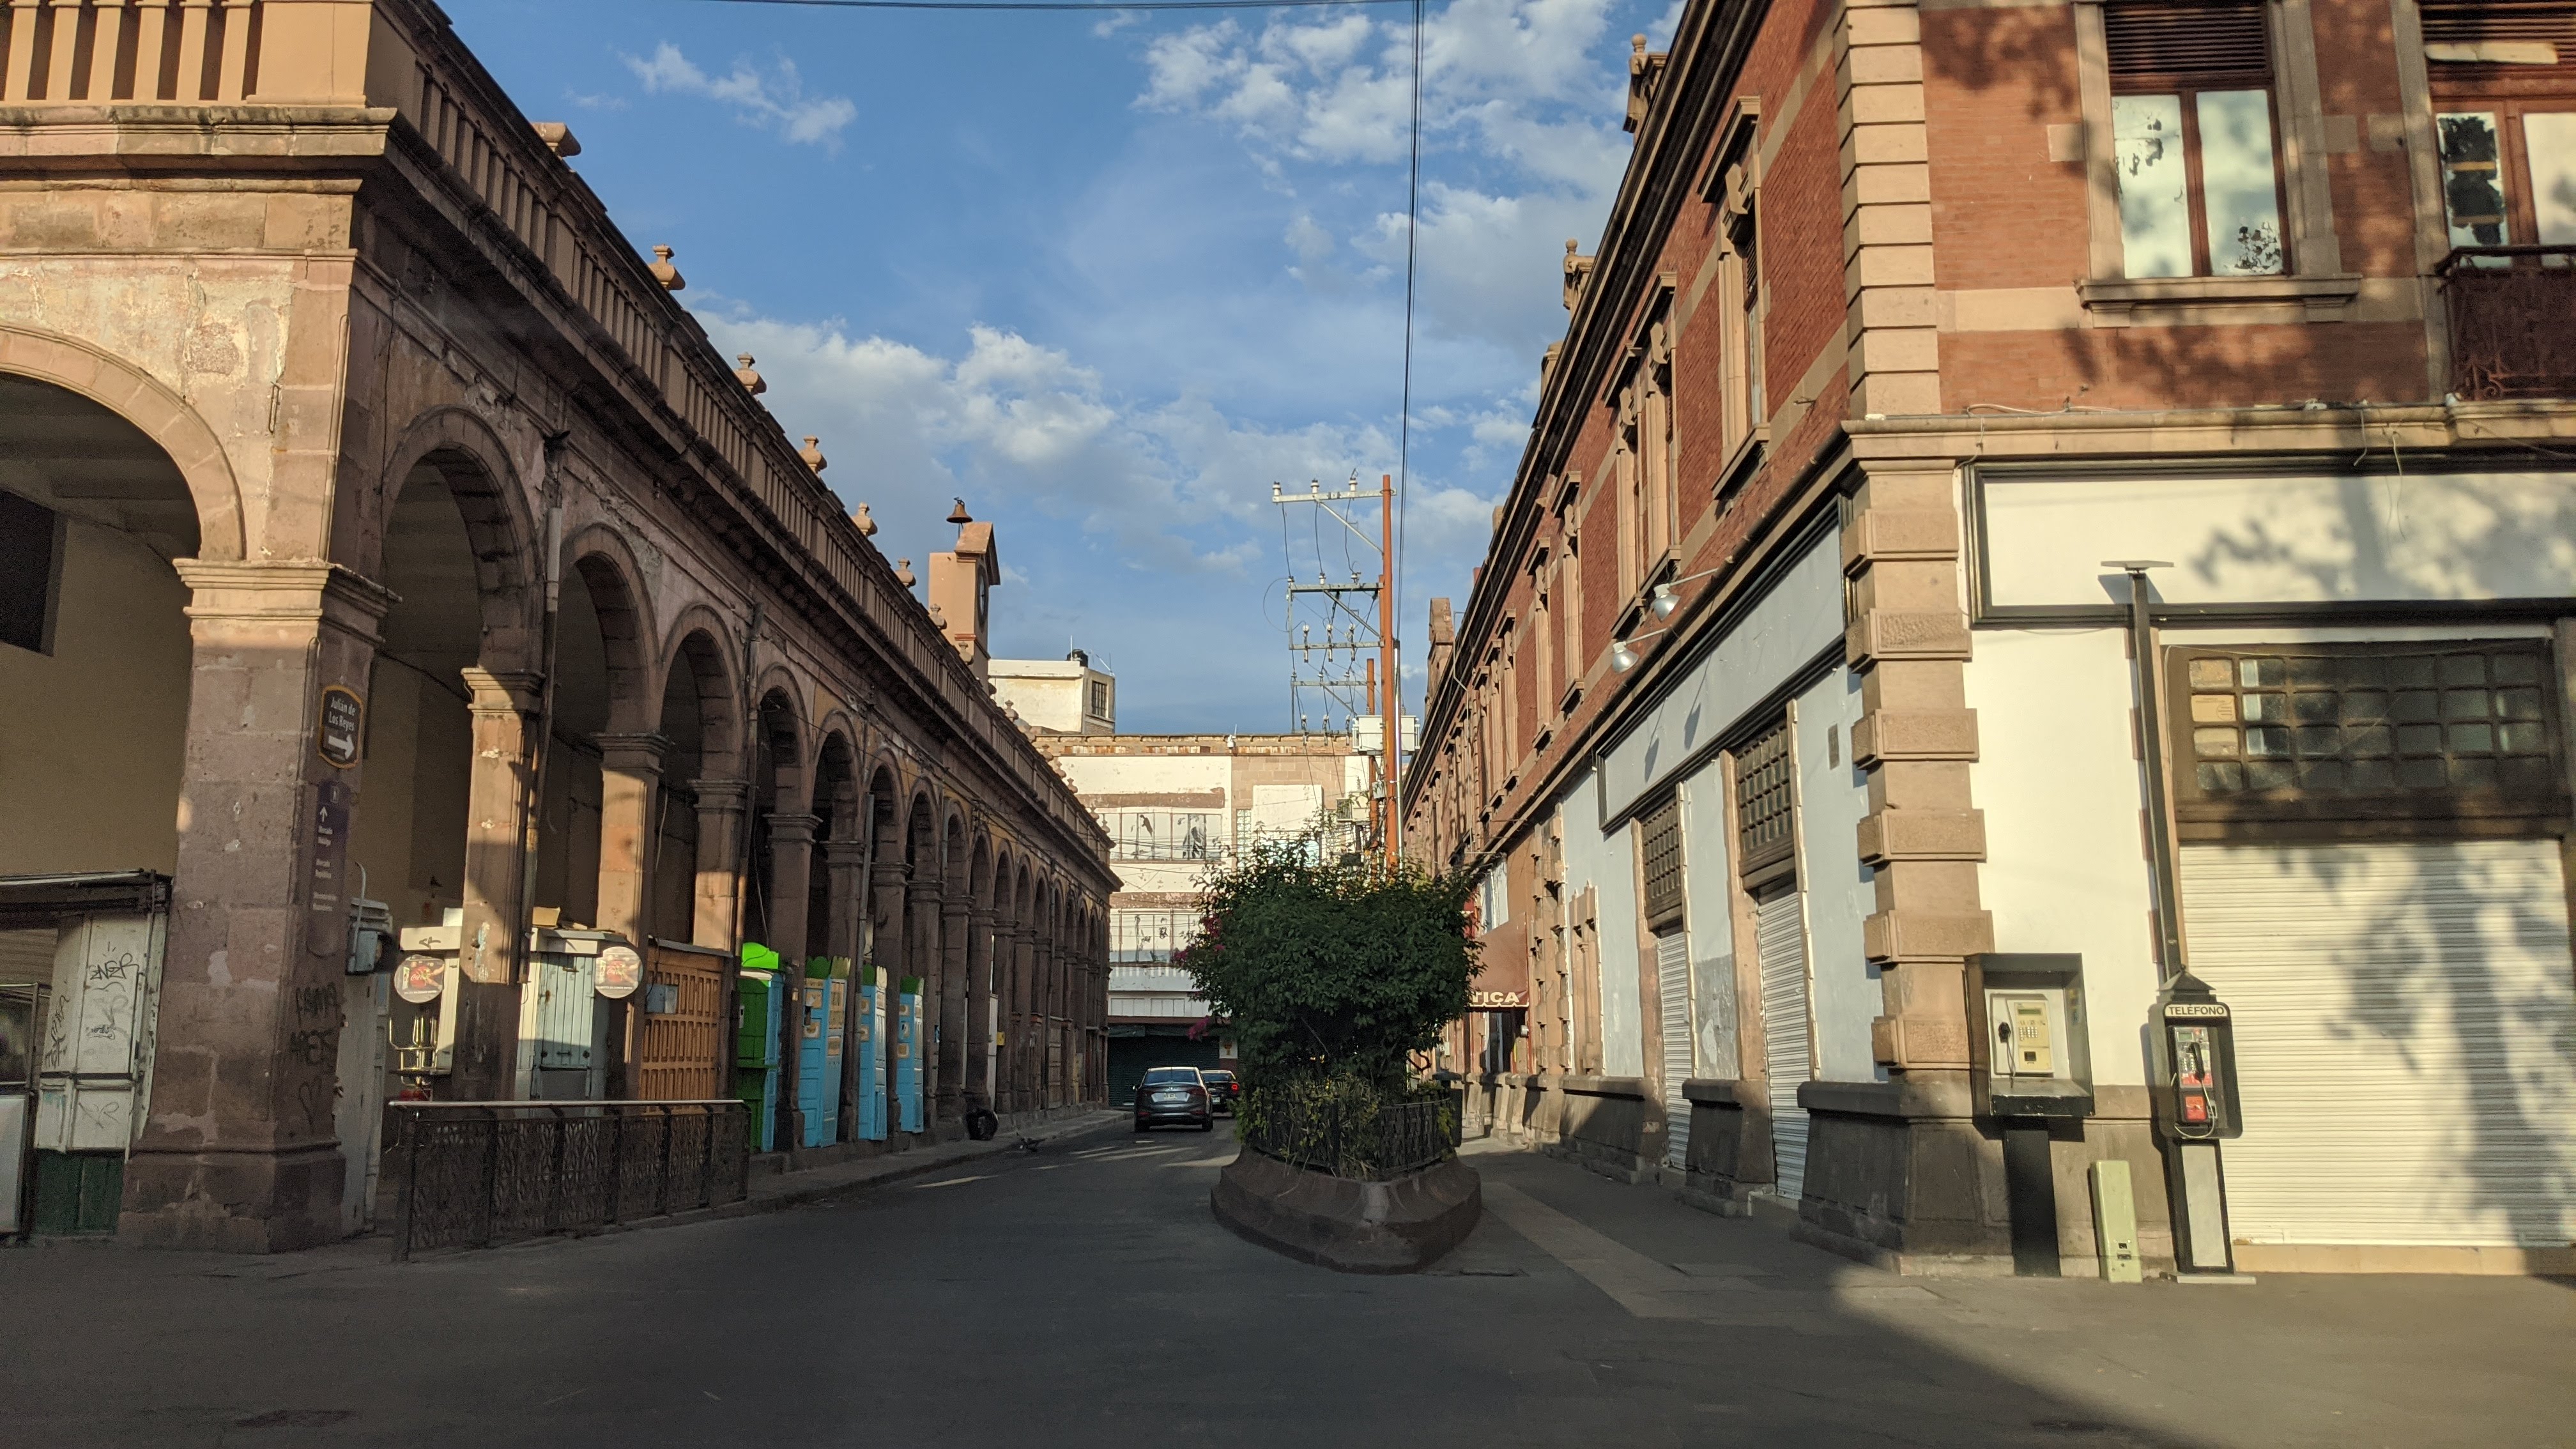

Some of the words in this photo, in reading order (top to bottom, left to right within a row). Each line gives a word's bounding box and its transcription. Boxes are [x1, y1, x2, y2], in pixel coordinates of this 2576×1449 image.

[330, 696, 348, 713] Julián
[348, 703, 355, 716] de
[328, 710, 339, 725] Los
[339, 715, 355, 732] Reyes
